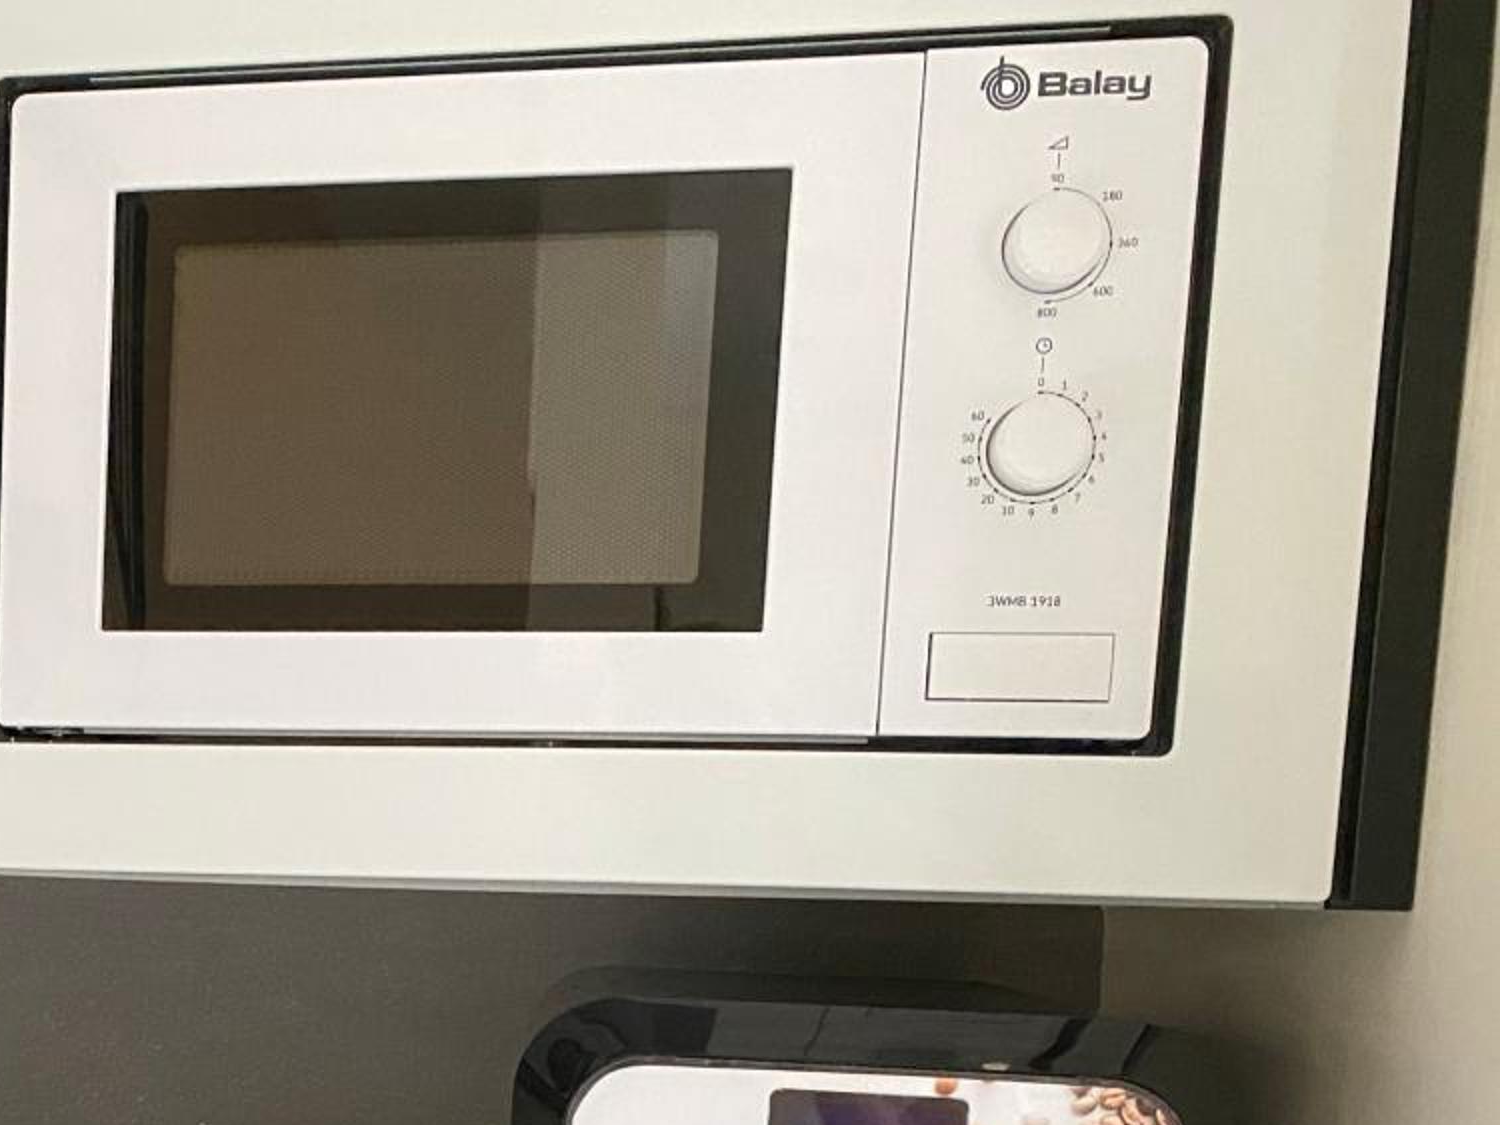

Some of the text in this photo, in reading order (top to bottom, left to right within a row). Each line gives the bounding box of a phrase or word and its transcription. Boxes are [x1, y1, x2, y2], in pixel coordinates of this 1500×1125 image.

[1037, 69, 1151, 101] Balay
[1102, 190, 1123, 201] 180
[1037, 377, 1045, 387] 0
[980, 494, 995, 505] 20
[1002, 505, 1015, 516] 10
